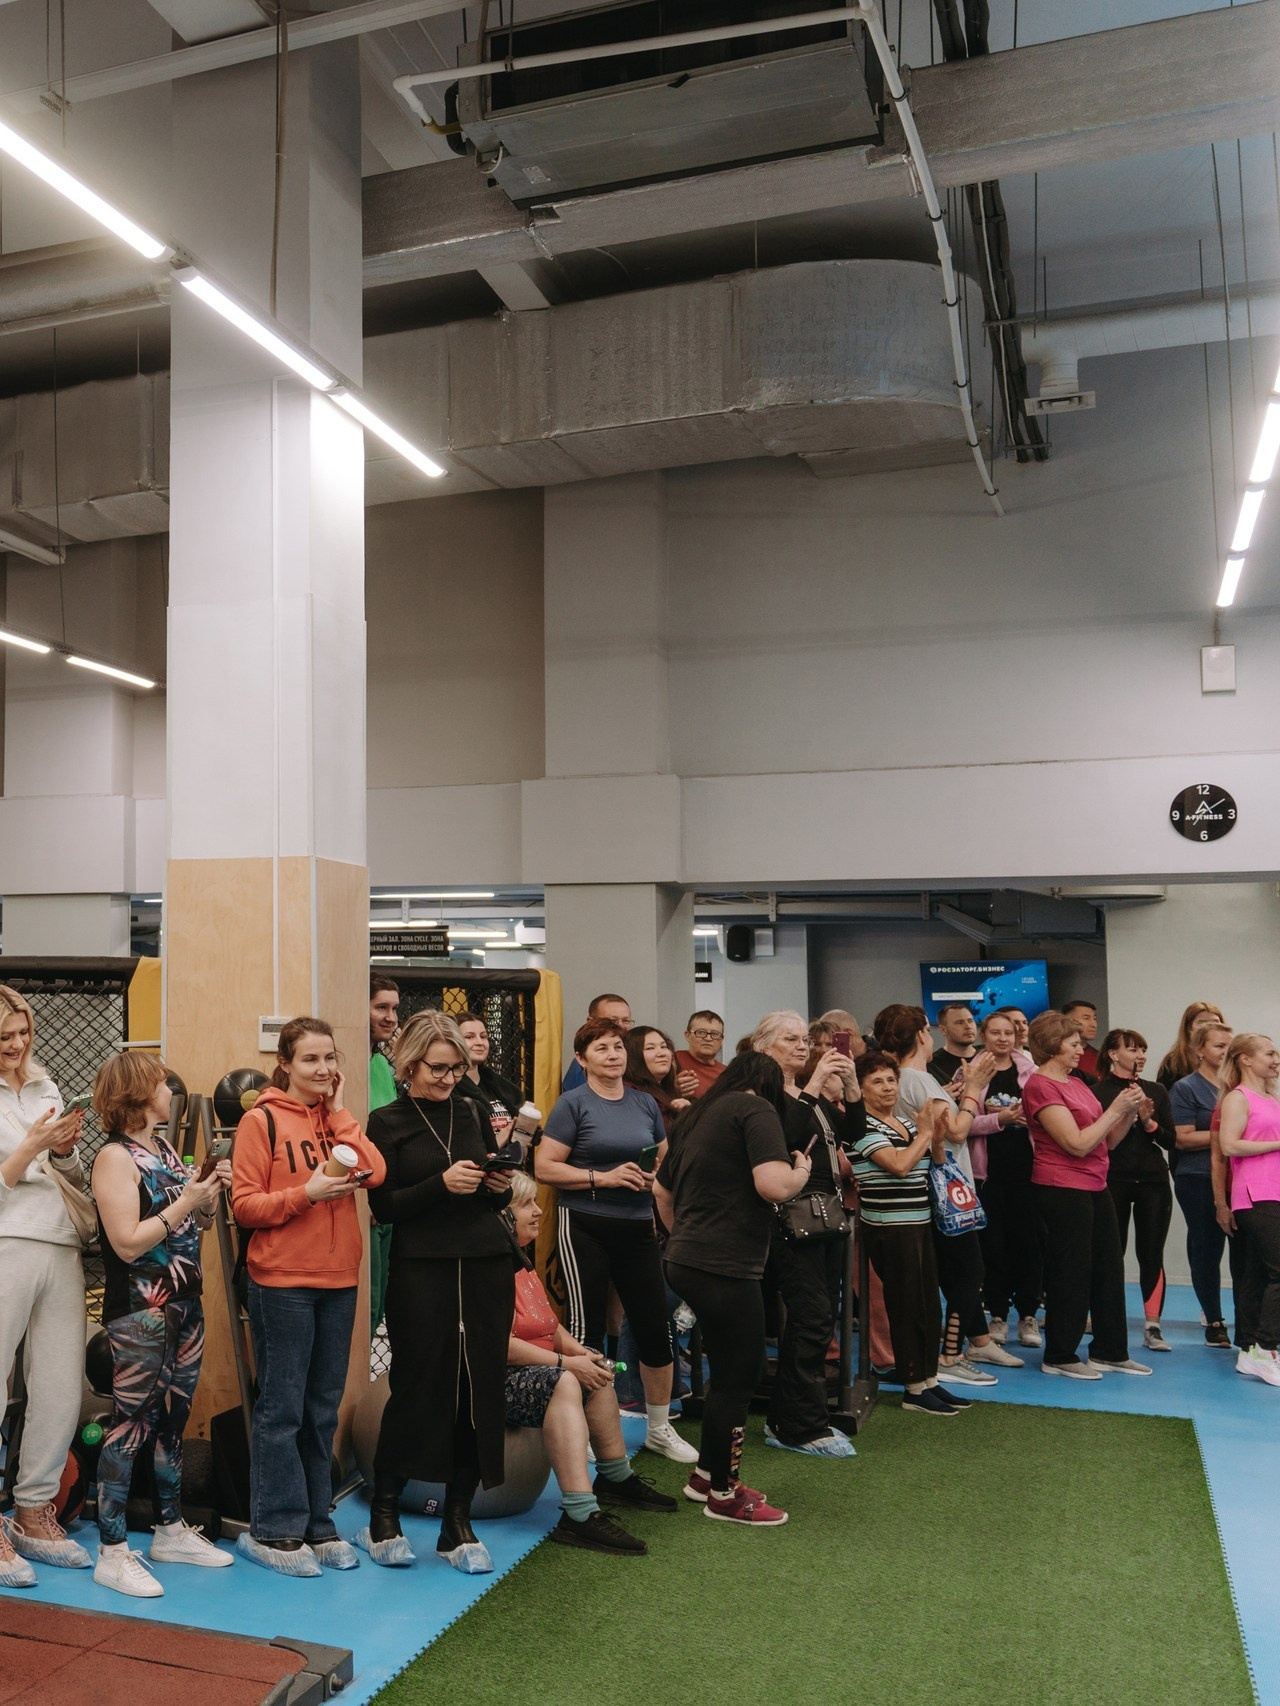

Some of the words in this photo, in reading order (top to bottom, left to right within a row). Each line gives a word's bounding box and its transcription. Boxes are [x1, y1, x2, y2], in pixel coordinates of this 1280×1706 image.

[1196, 785, 1210, 795] 12
[1171, 811, 1180, 821] 9
[1227, 809, 1236, 820] 3
[1200, 831, 1209, 841] 6
